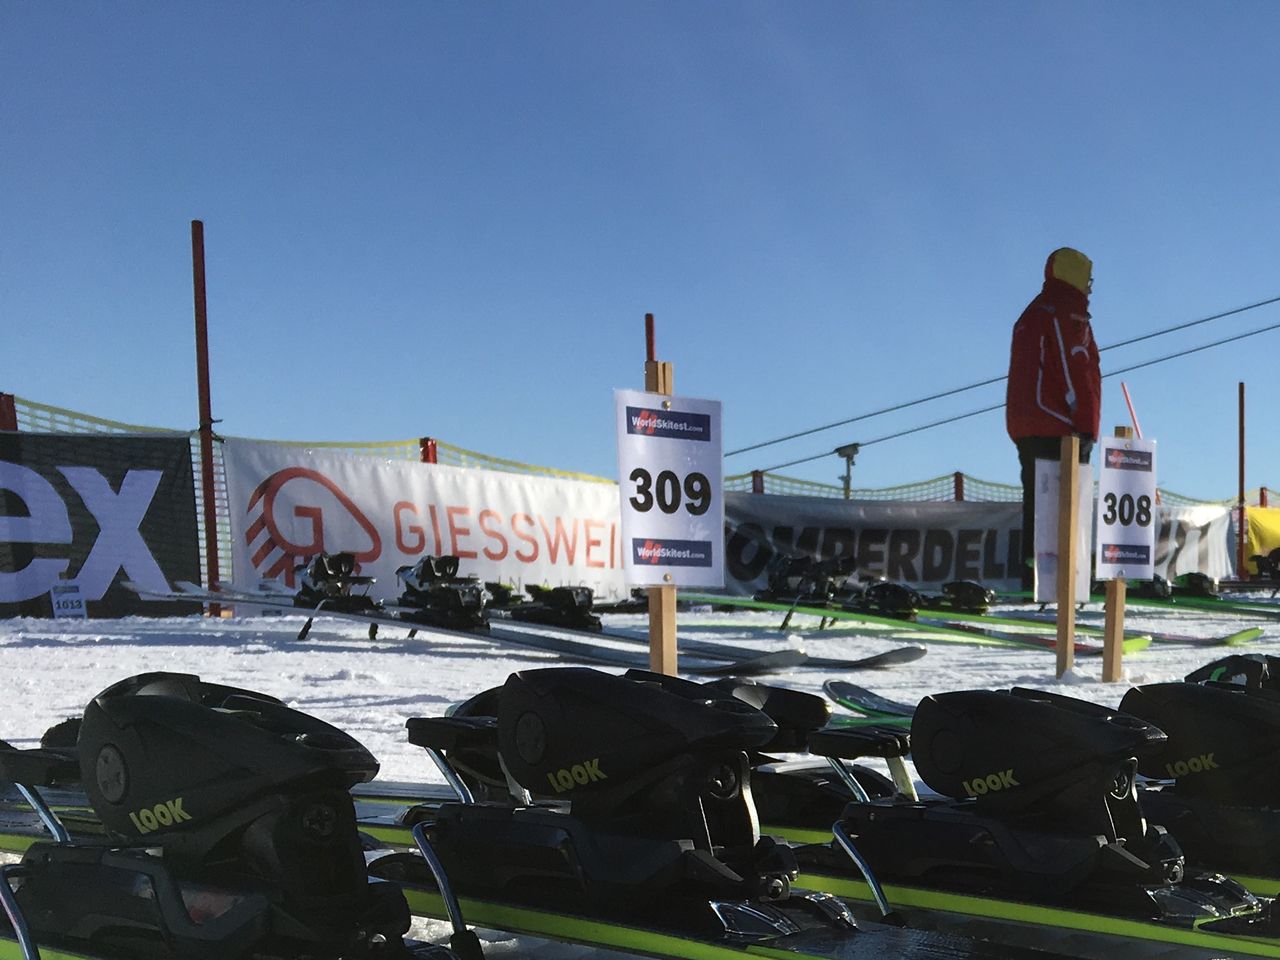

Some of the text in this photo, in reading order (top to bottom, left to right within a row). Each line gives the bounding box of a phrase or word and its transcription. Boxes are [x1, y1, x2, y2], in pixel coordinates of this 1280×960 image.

[631, 415, 703, 433] WorldSkitest.com
[629, 467, 711, 516] 309
[1102, 492, 1151, 527] 308
[393, 501, 624, 569] GIESSWEI
[546, 758, 608, 793] LOOK
[1165, 752, 1219, 778] LOOK
[962, 769, 1020, 797] LOOK
[129, 797, 192, 834] LOOK
